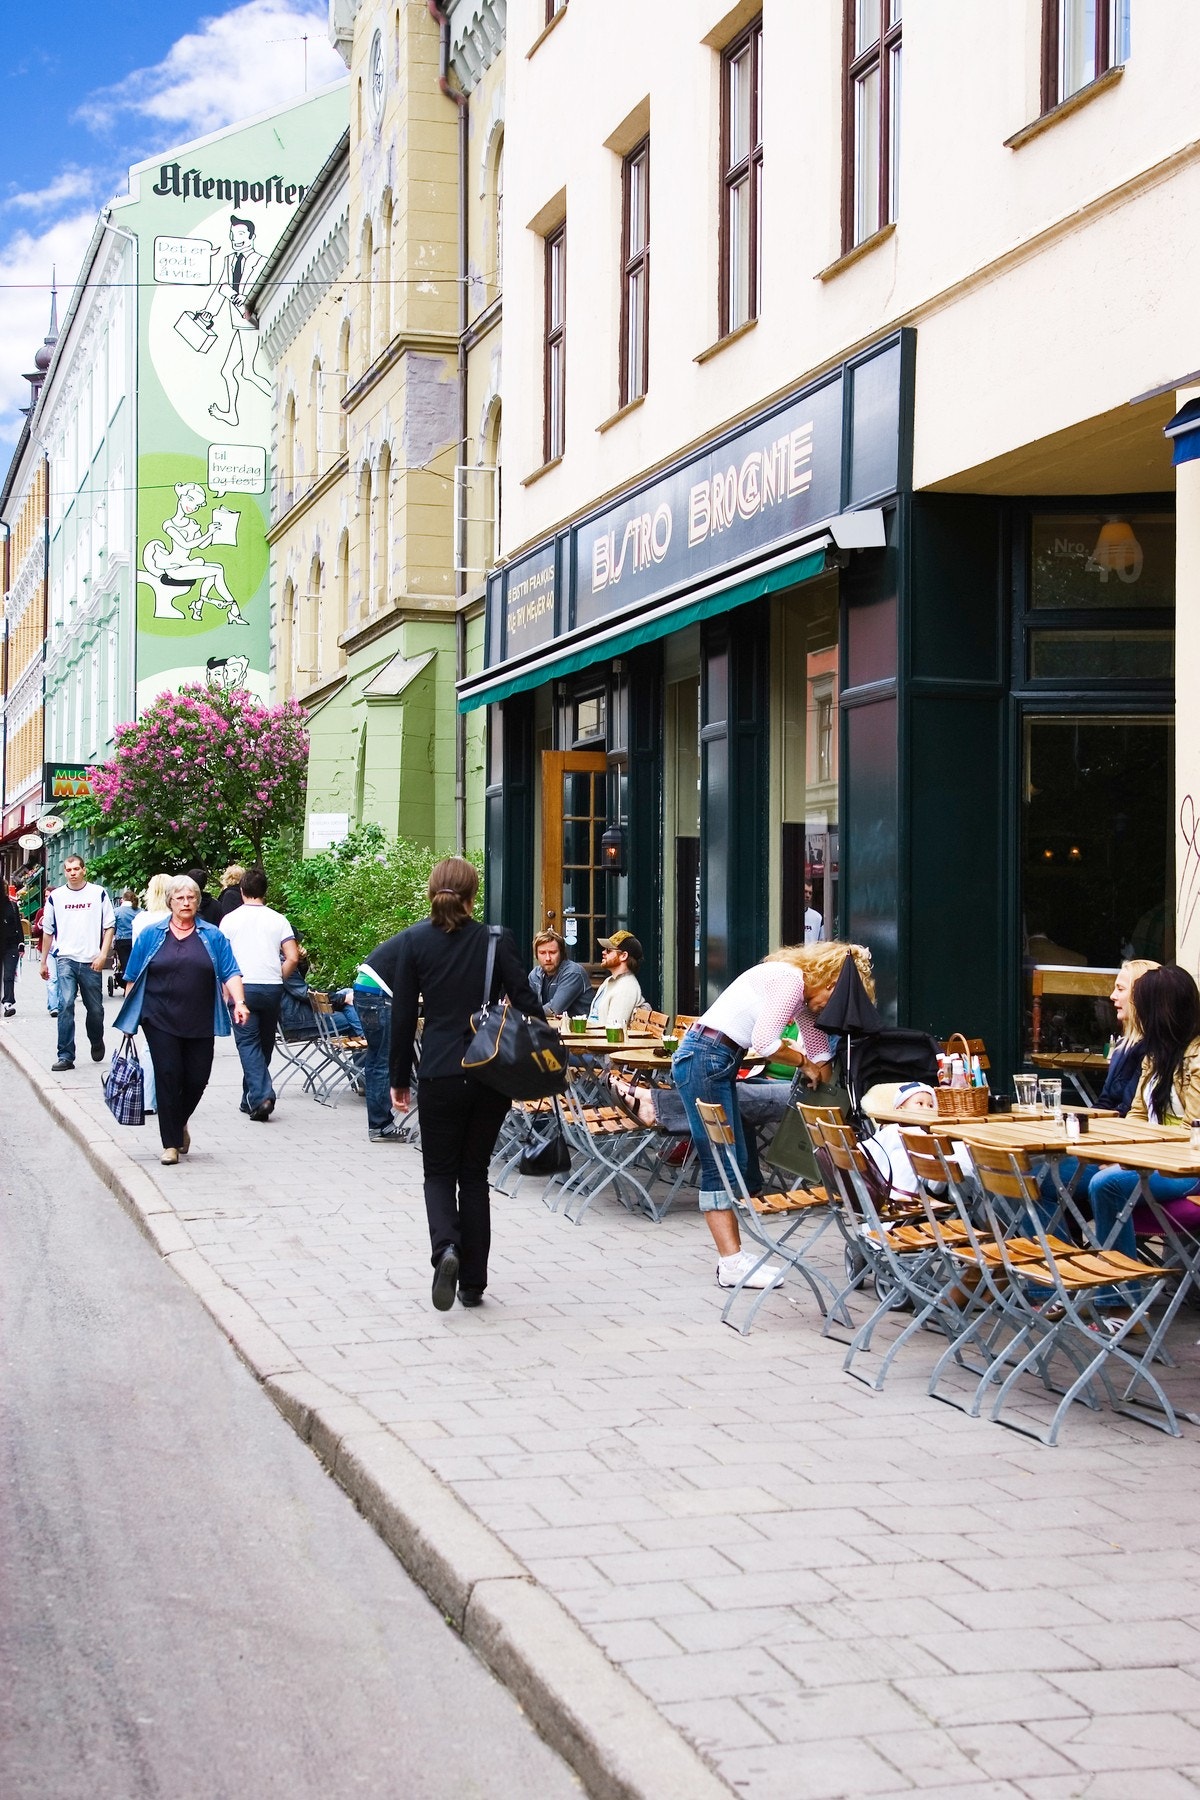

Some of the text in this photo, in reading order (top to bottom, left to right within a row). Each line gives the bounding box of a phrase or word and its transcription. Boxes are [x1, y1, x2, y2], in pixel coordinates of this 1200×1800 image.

[158, 242, 186, 254] Det
[214, 450, 227, 461] til
[212, 462, 261, 477] hverdag
[212, 475, 258, 487] og fest
[592, 502, 673, 594] BISTRO
[1085, 538, 1144, 584] 40
